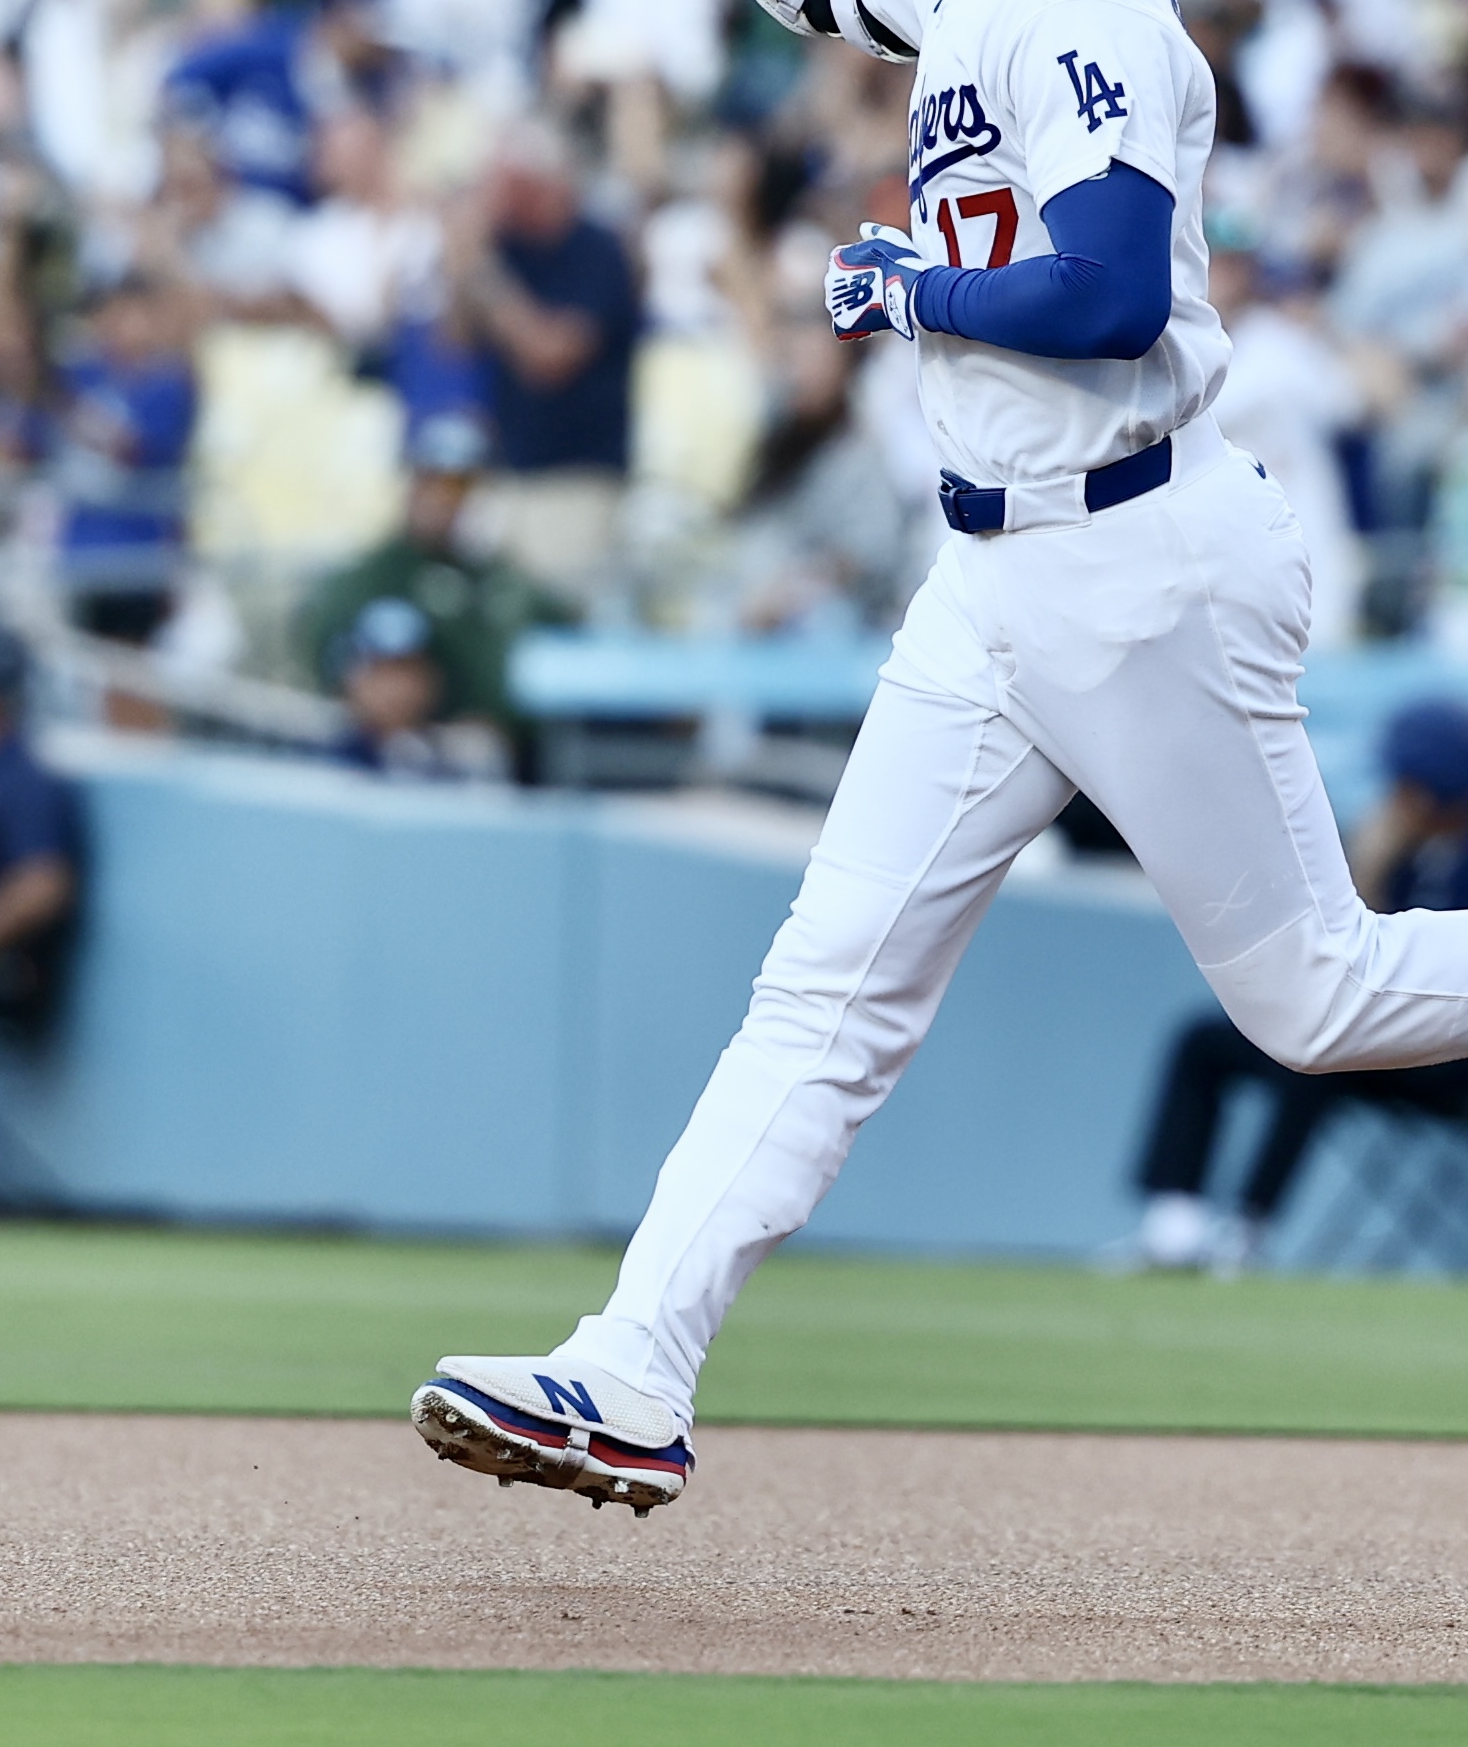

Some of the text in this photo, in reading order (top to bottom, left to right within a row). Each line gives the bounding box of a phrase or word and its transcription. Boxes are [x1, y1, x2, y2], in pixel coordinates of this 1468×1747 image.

[1057, 50, 1128, 134] LA
[937, 187, 1019, 268] 17
[532, 1373, 604, 1424] N
